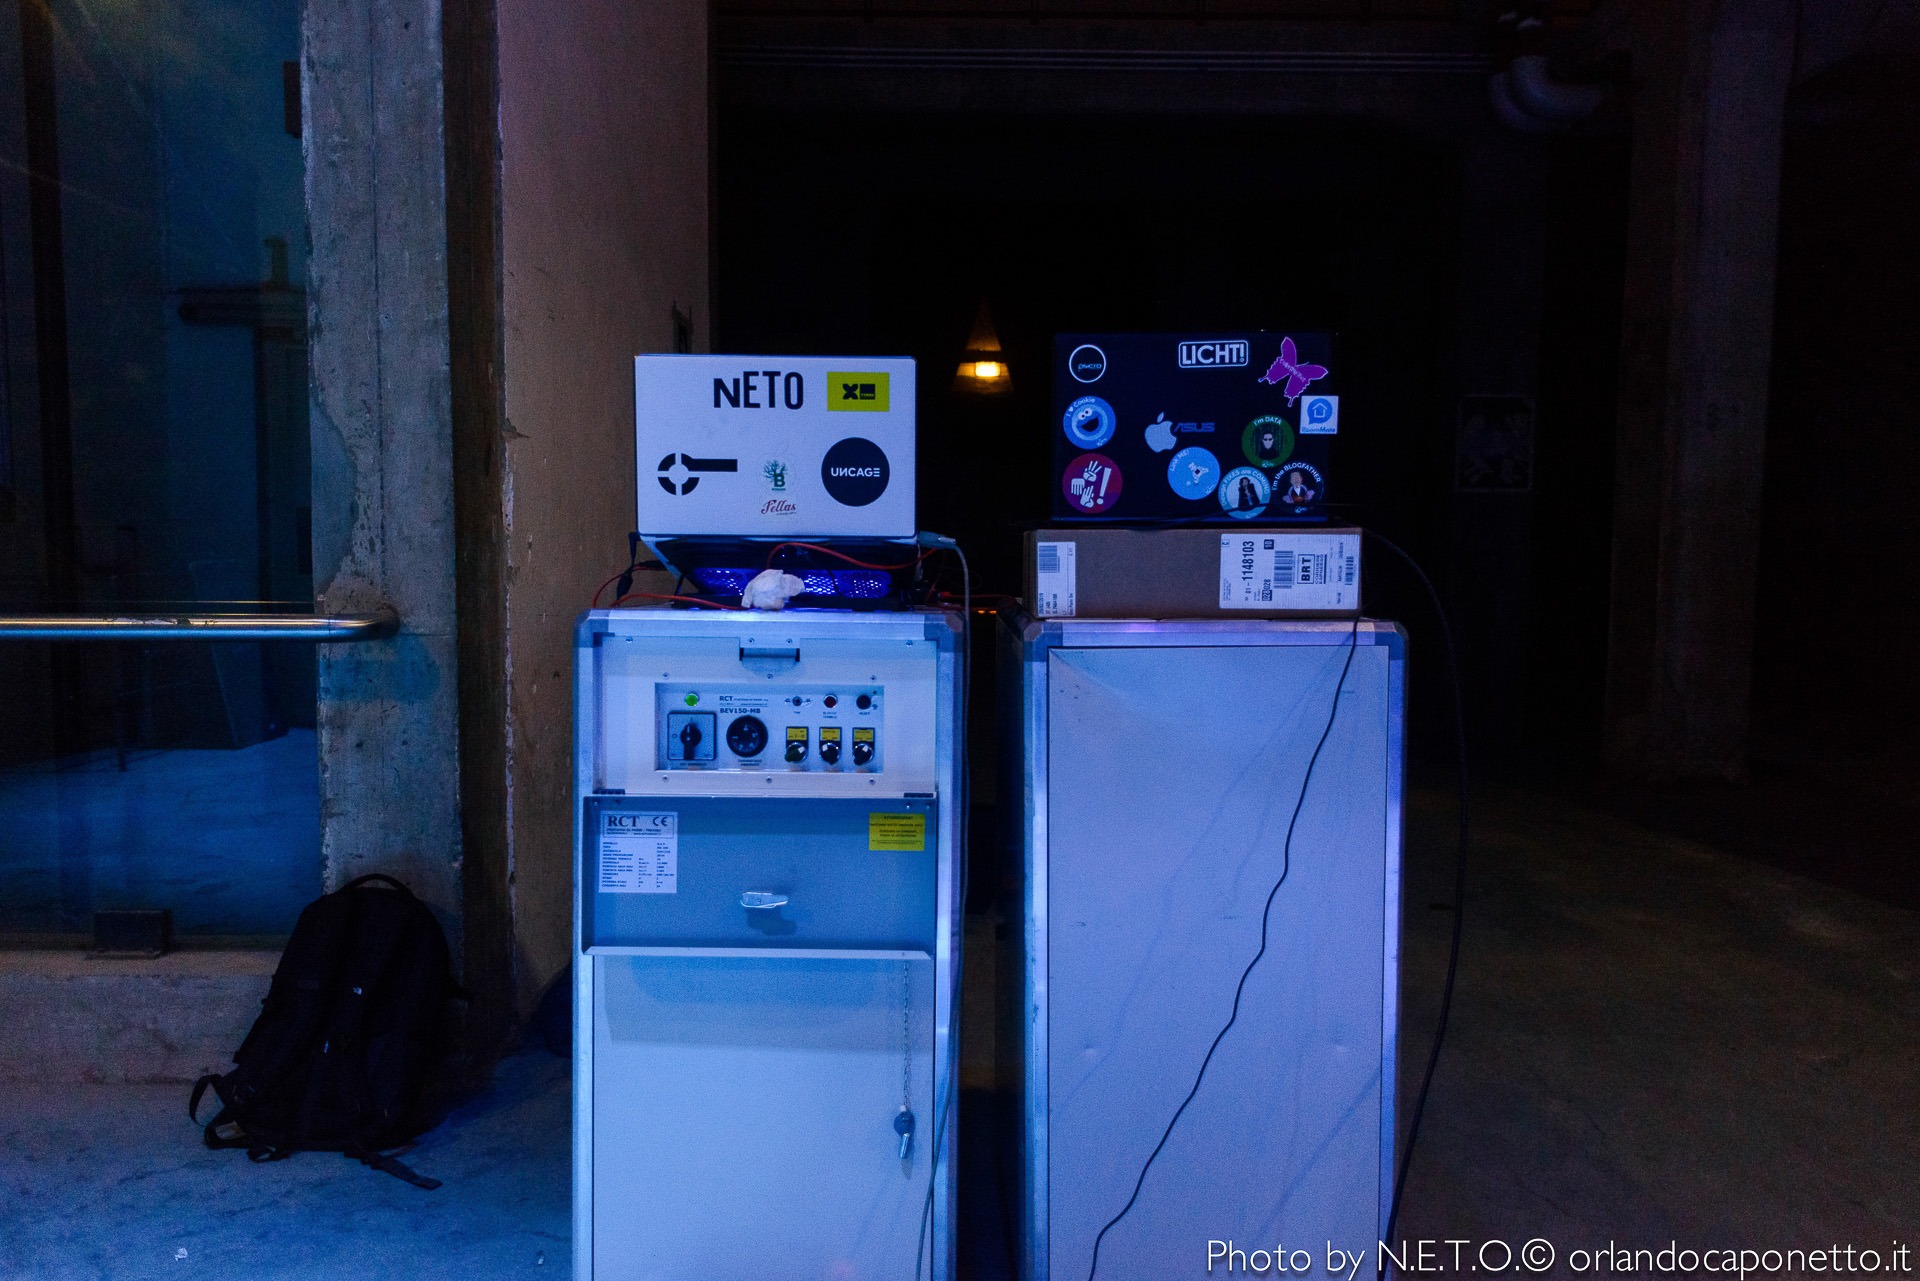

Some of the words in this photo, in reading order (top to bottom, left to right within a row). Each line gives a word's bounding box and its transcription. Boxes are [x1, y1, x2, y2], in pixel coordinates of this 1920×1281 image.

[1181, 343, 1246, 365] LICHT!
[713, 371, 804, 410] NETO
[1073, 397, 1095, 408] Cookie
[1173, 422, 1215, 433] ASUS
[1253, 418, 1264, 427] I'm
[1265, 416, 1282, 426] DATA
[830, 467, 880, 477] UNCAGE
[1275, 469, 1285, 480] the
[1283, 462, 1321, 483] BLOGFATHER
[1224, 469, 1241, 484] FIXES
[1252, 469, 1270, 495] COMING
[760, 499, 797, 515] Fellas
[1241, 541, 1255, 581] 1148103
[1301, 557, 1311, 582] BRT
[608, 816, 639, 827] RCT
